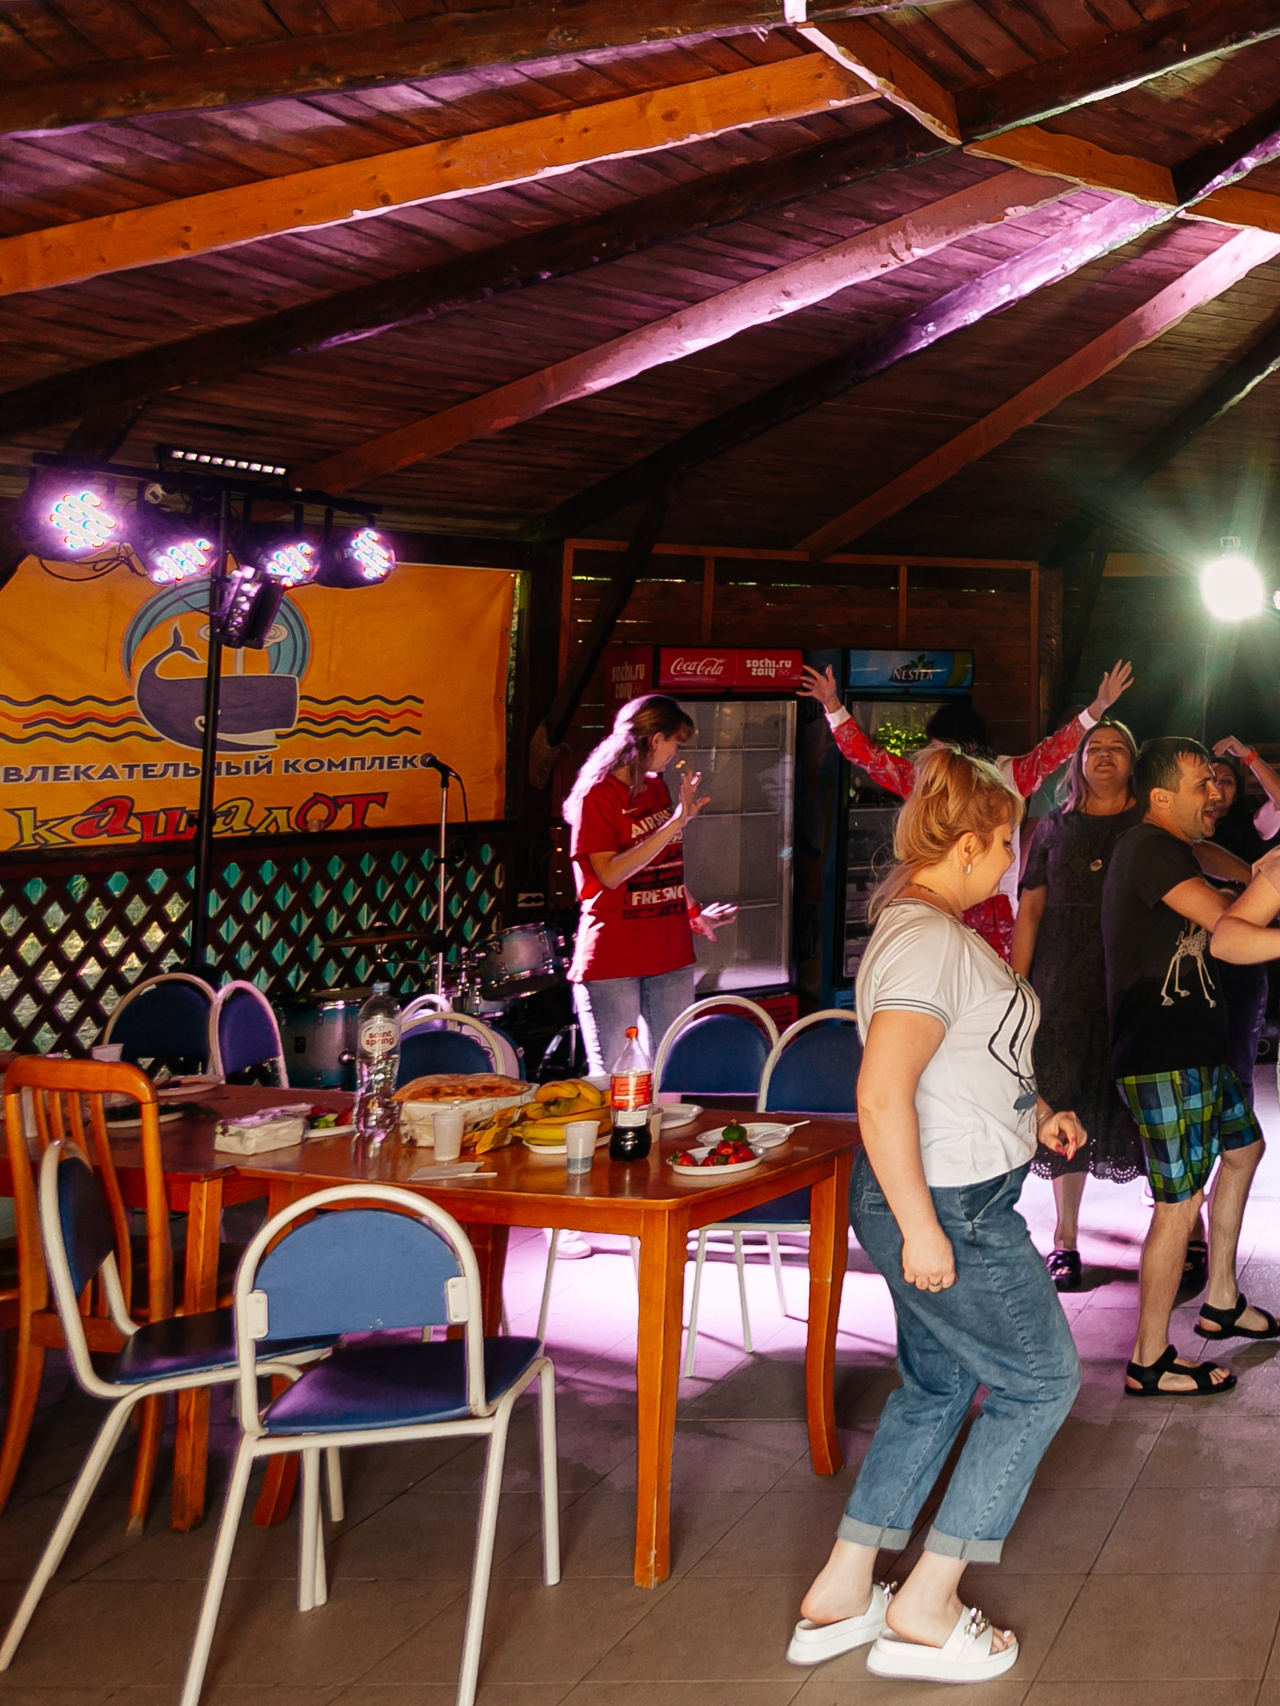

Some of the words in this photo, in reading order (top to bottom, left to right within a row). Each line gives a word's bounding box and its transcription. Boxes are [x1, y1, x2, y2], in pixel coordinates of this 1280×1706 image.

[746, 658, 792, 668] sochi.ru
[751, 667, 776, 678] 2014
[892, 668, 934, 681] NESTEA
[284, 755, 433, 774] КОМПЛЕК
